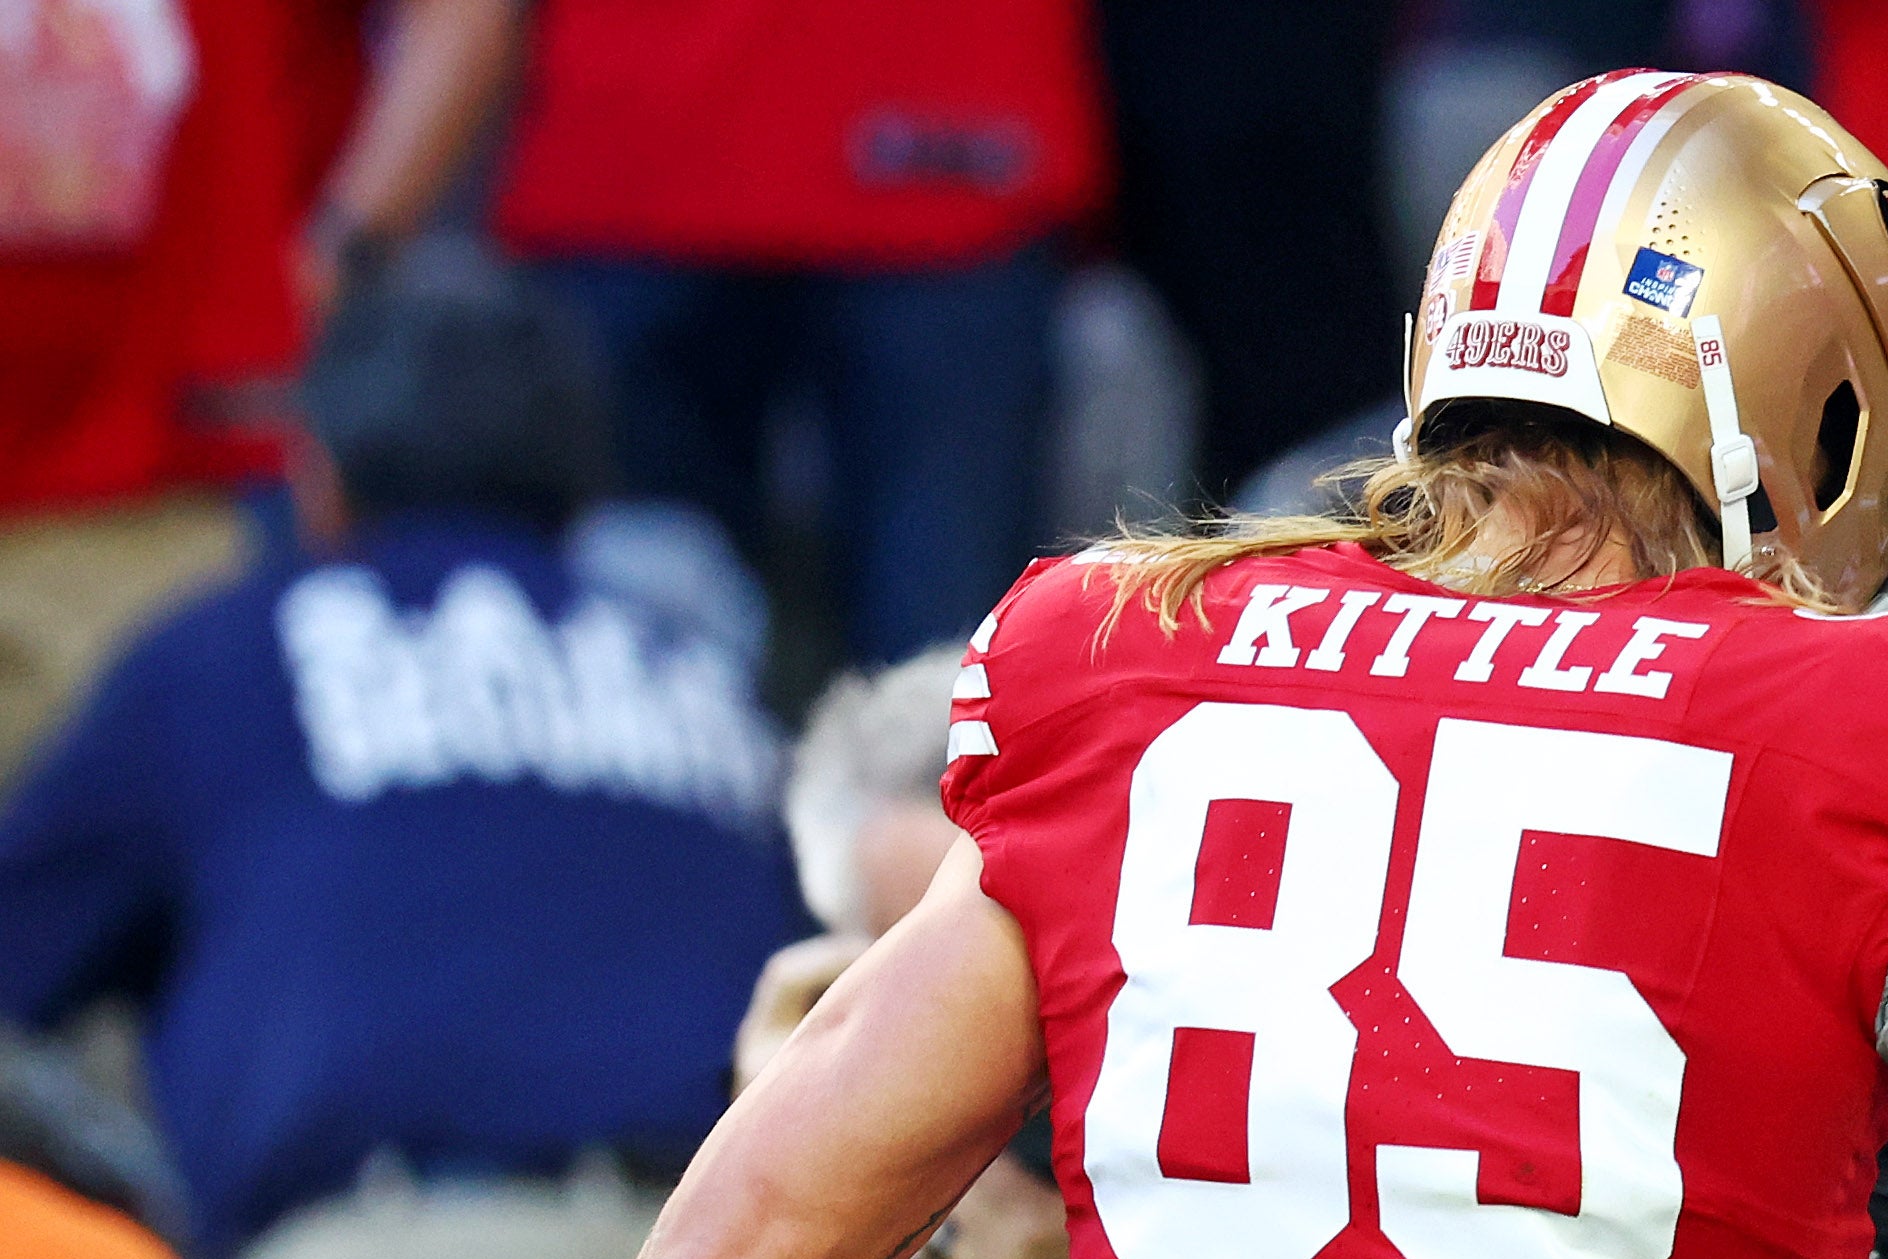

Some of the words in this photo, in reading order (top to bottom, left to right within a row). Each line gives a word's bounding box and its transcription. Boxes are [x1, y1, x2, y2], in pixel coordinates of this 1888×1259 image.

[1445, 319, 1571, 378] 49ERS
[1700, 338, 1723, 367] 85
[1216, 584, 1710, 699] KITTLE
